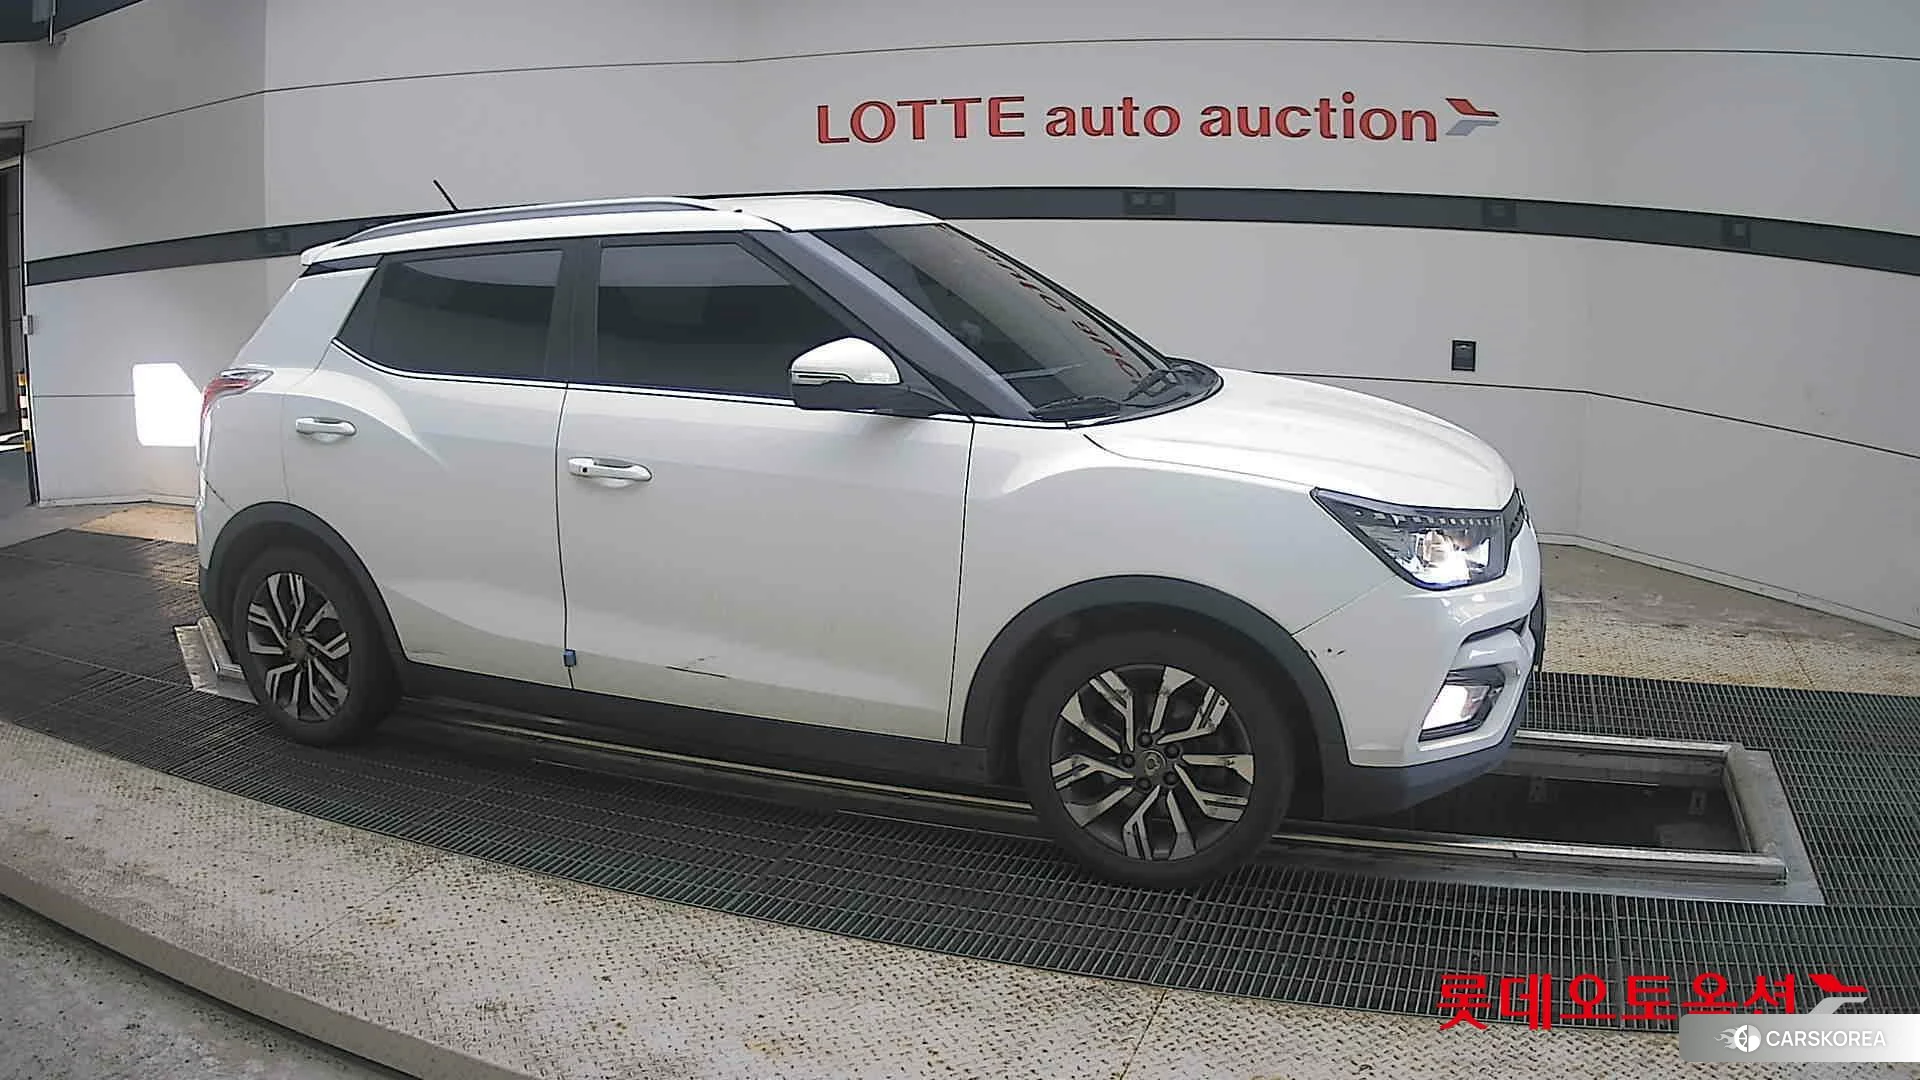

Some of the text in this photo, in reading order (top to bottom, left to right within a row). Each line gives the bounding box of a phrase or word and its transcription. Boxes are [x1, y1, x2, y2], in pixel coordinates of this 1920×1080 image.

[817, 91, 1438, 144] LOTTE auto auction
